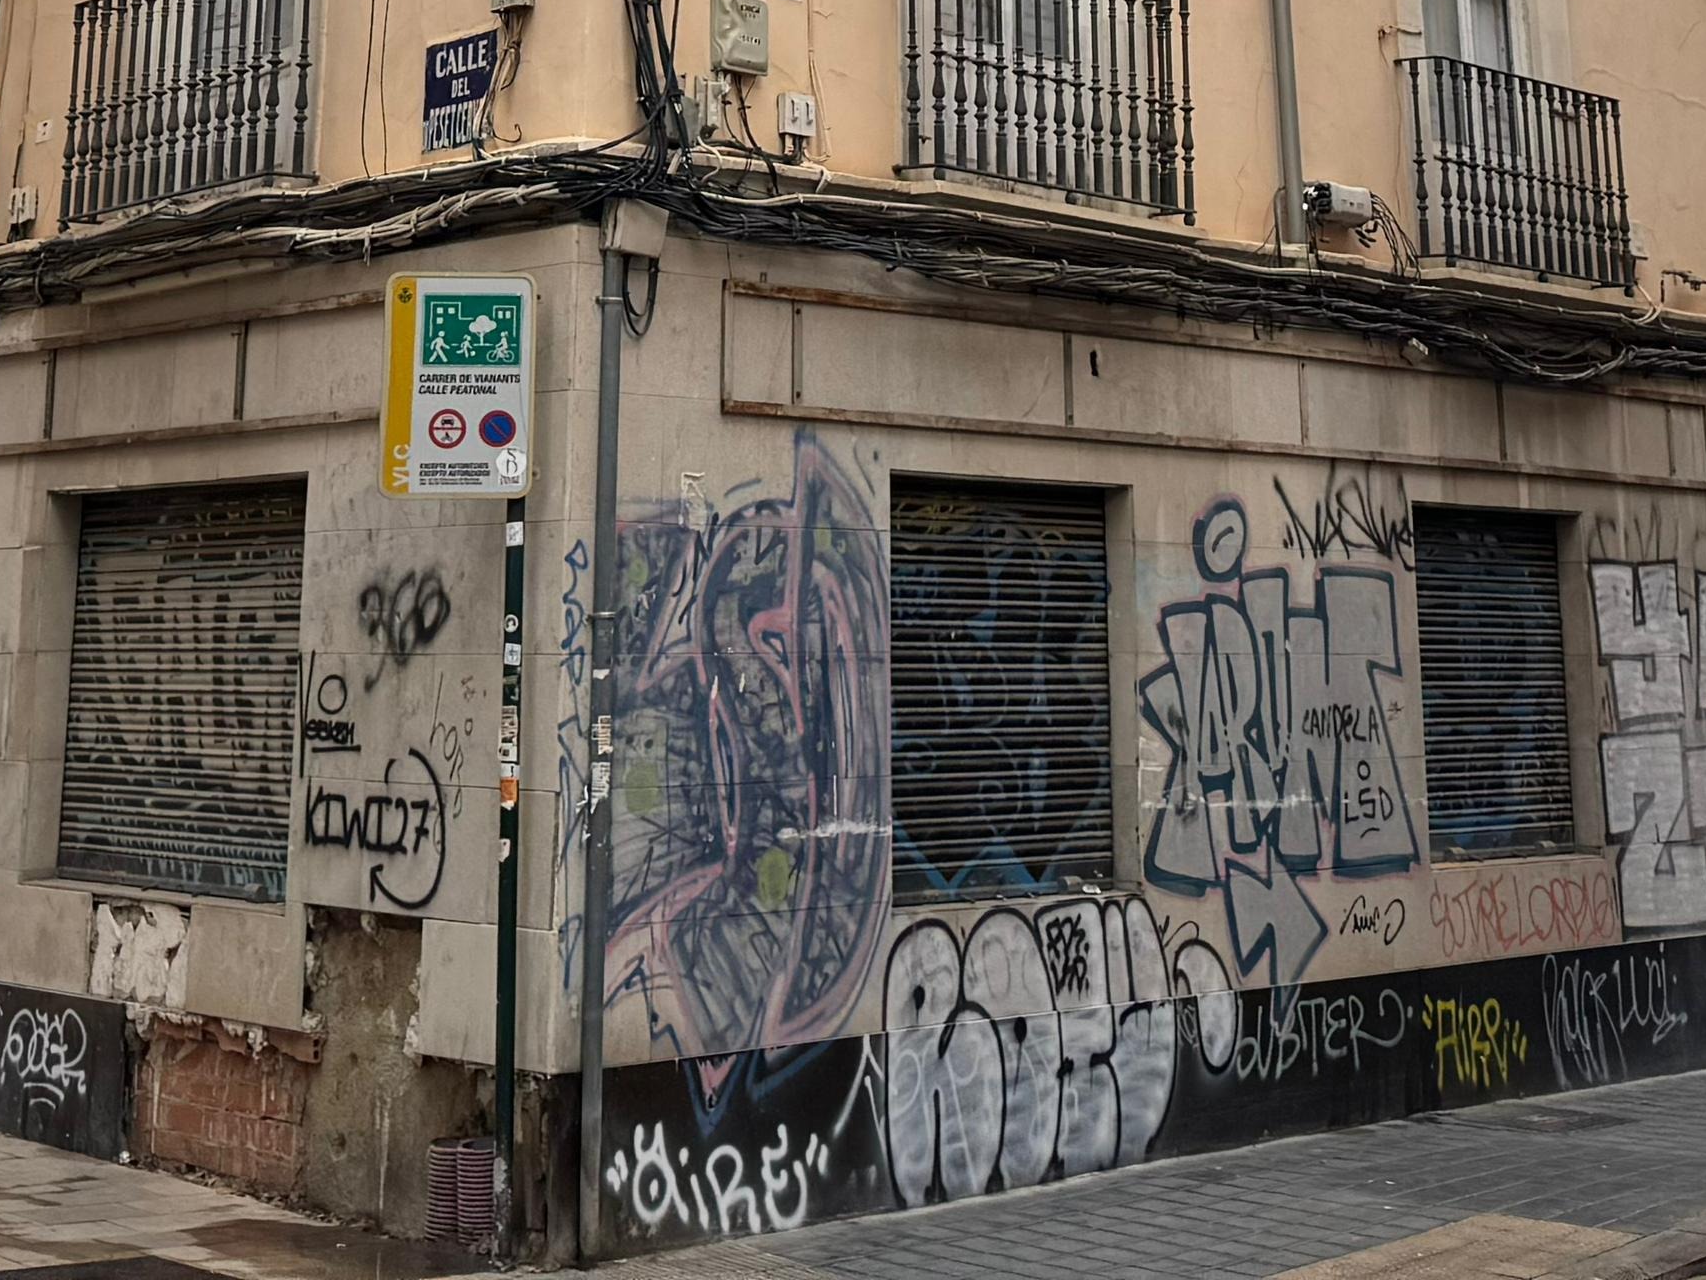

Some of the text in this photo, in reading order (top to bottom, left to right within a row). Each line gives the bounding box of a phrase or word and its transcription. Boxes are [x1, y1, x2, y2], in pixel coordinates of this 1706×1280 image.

[435, 39, 488, 78] CALLE
[451, 76, 471, 98] DEL
[418, 385, 498, 395] CALLE PEATONAL
[419, 373, 521, 383] CARRER DE VIANANTS
[392, 443, 410, 487] VLC
[1344, 786, 1394, 824] LSD
